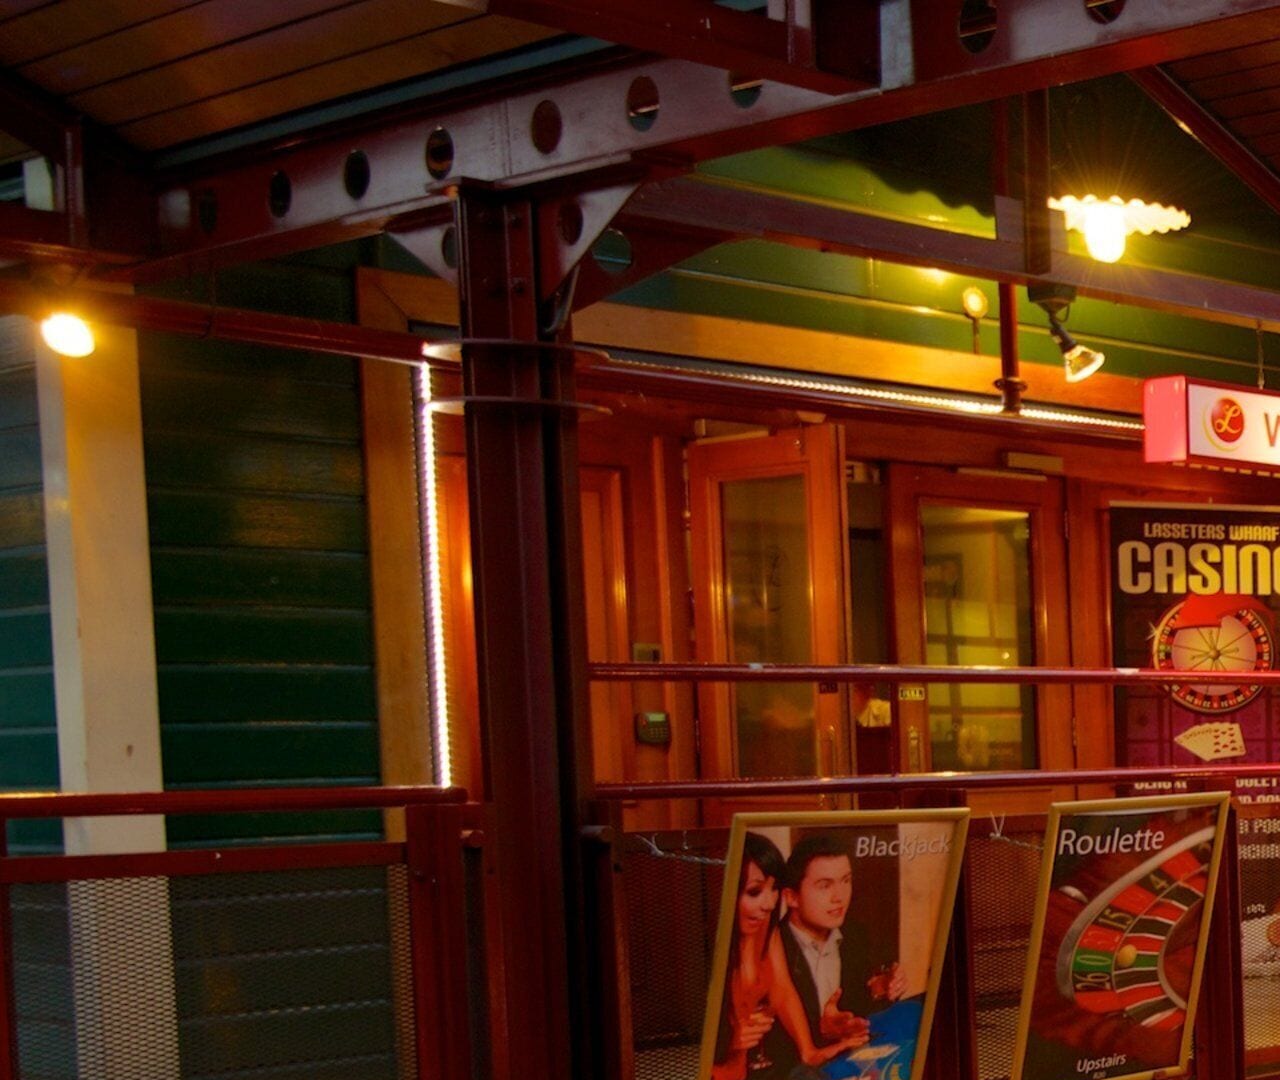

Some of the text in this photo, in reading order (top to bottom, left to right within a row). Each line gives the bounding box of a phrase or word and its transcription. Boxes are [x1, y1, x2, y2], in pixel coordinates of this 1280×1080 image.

[1143, 522, 1280, 542] LASSETERS WHARF
[855, 833, 951, 861] Blackjack
[1058, 827, 1166, 855] Roulette
[1076, 1053, 1128, 1075] Upstairs
